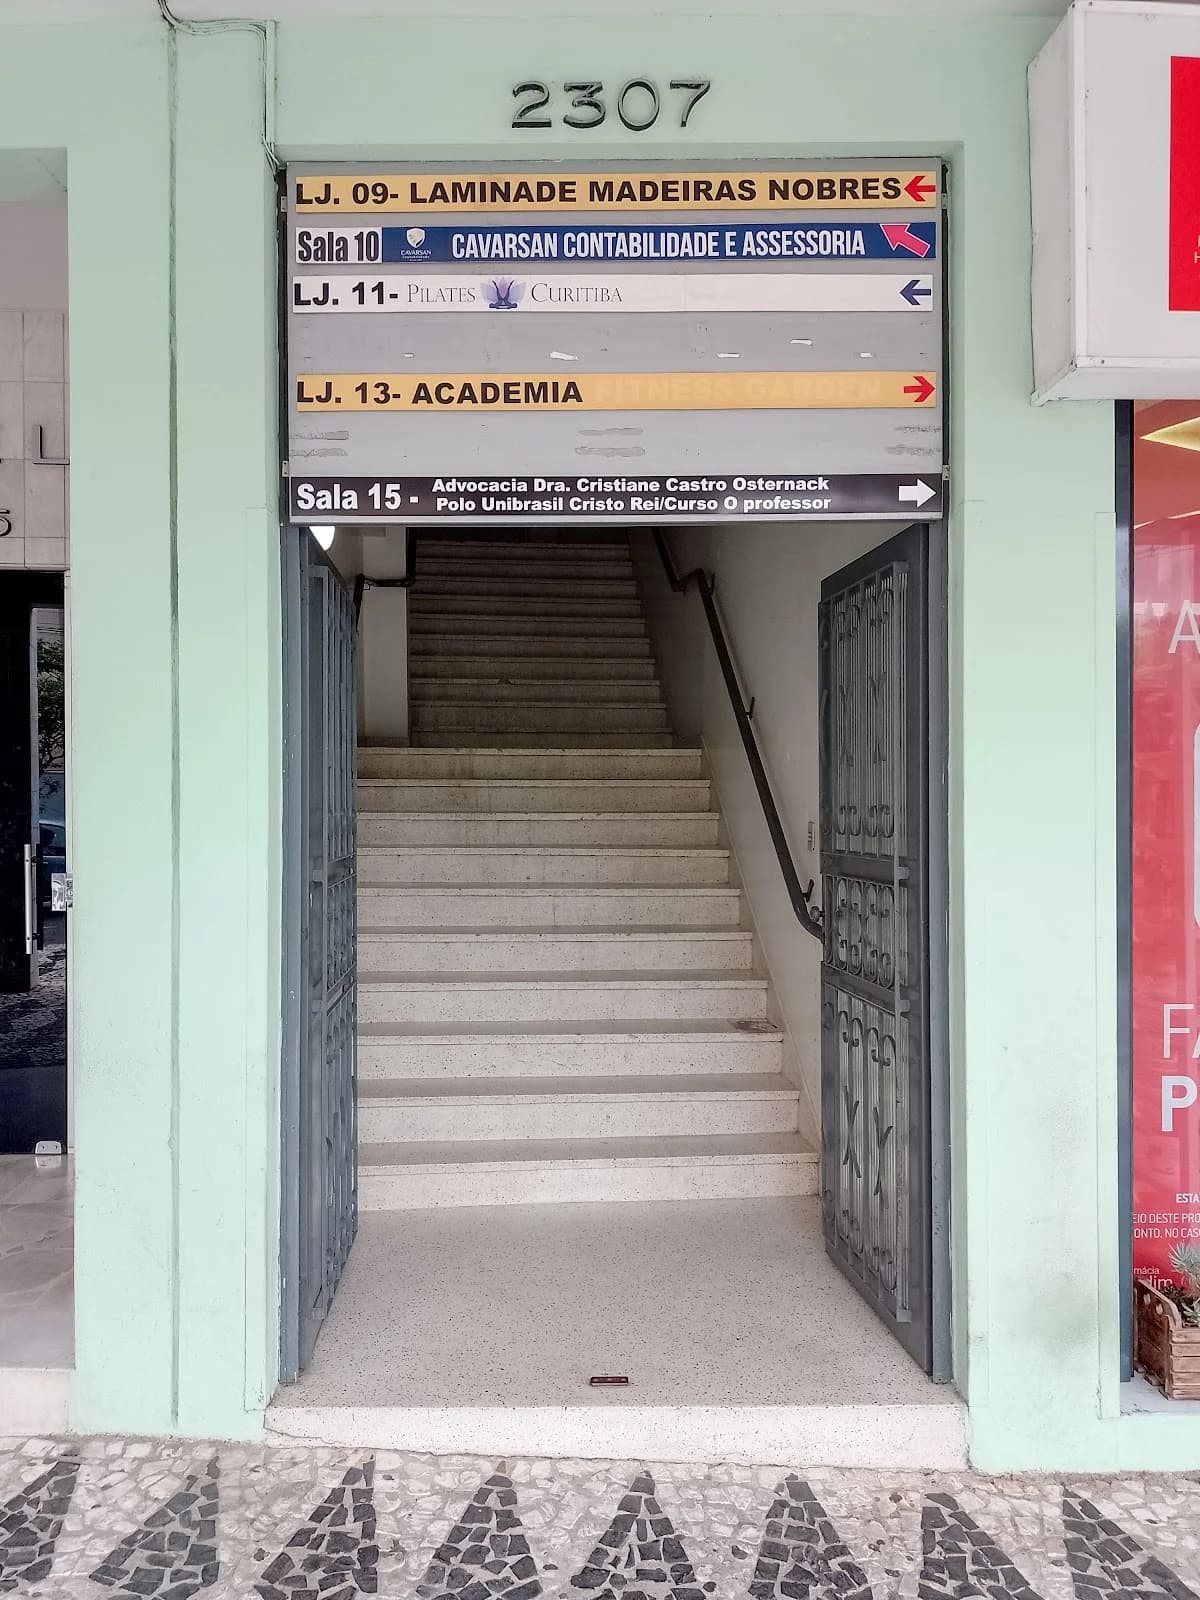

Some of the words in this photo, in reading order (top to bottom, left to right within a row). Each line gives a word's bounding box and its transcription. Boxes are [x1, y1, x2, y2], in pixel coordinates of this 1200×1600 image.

[511, 79, 712, 131] 2307
[296, 183, 340, 205] LJ.
[352, 182, 399, 205] 09-
[410, 181, 577, 204] LAMINADE
[589, 178, 757, 203] MADEIRAS
[768, 177, 901, 201] NOBRES
[298, 231, 349, 262] Sala
[354, 231, 379, 261] 10
[452, 233, 557, 259] CAVARSAN
[563, 231, 721, 258] CONTABILIDADE
[725, 231, 737, 256] E
[742, 230, 866, 256] ASSESSORIA
[294, 282, 339, 305] LJ.
[352, 281, 398, 304] 11-
[407, 283, 476, 304] PILATES
[531, 282, 622, 303] CURITIBA
[296, 381, 342, 404] LJ.
[354, 382, 401, 404] 13-
[412, 381, 583, 404] ACADEMIA
[432, 479, 528, 493] Advocacia
[533, 479, 571, 493] Dra.
[576, 478, 660, 493] Cristiane
[665, 478, 727, 493] Castro
[732, 477, 829, 492] Osternack
[297, 484, 359, 510] Sala
[368, 484, 401, 510] 15
[436, 498, 476, 512] Polo
[481, 497, 563, 511] Unibrasil
[569, 496, 625, 511] Cristo
[630, 495, 718, 511] Rei/Curso
[723, 496, 738, 510] O
[743, 496, 831, 513] professor
[1149, 1213, 1180, 1224] DESTE
[1164, 1227, 1179, 1238] NO
[1180, 1227, 1200, 1238] CAS
